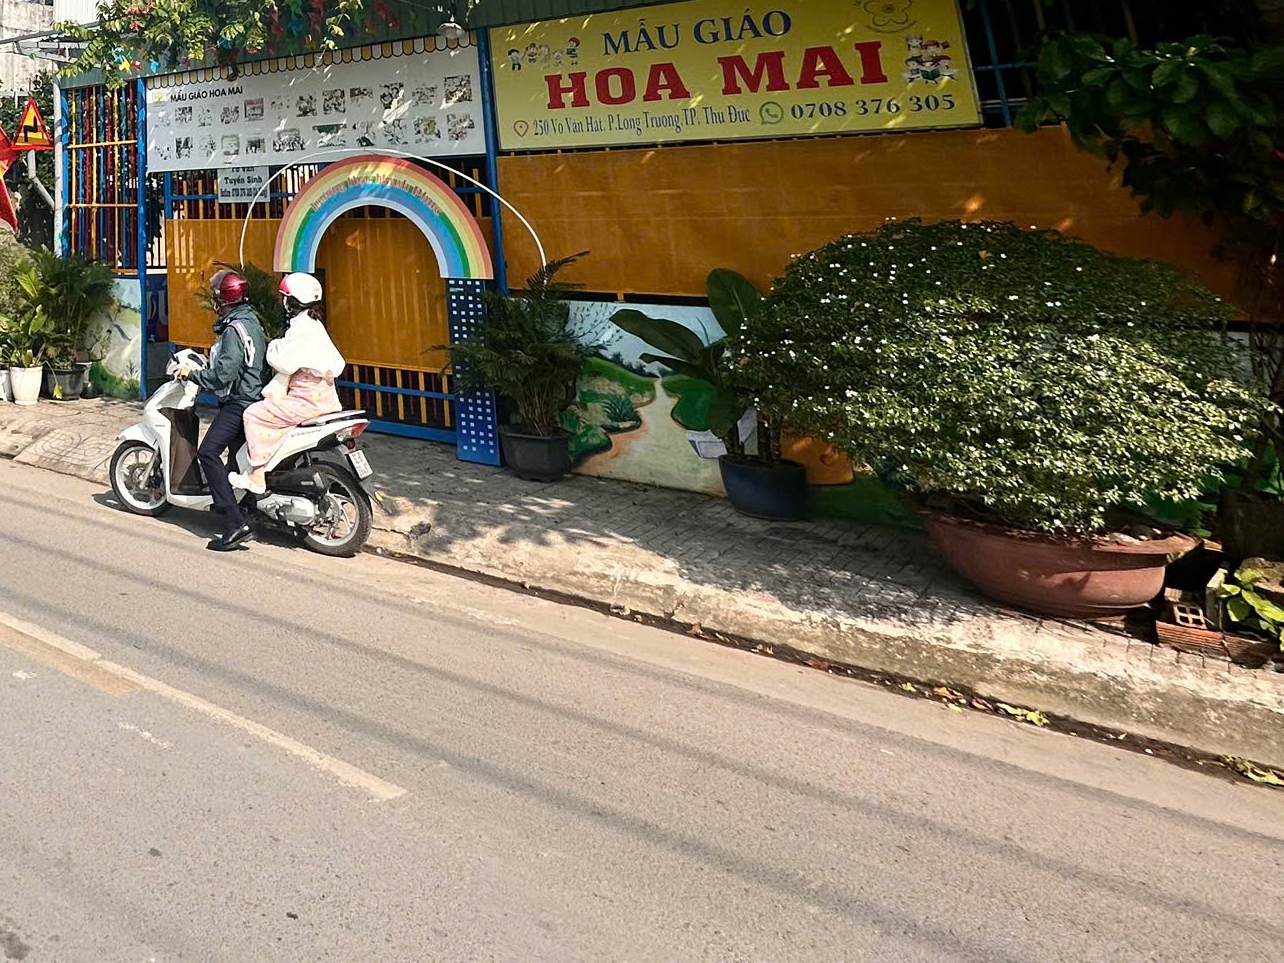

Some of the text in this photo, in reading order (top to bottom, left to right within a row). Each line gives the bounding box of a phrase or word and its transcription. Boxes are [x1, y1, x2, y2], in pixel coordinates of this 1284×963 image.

[601, 8, 792, 56] MẪU GIÁO
[544, 41, 889, 109] HOA MAI
[209, 87, 227, 98] HOA
[227, 86, 243, 95] MAI
[791, 94, 956, 119] 0708 376 305
[532, 119, 550, 136] 250
[247, 175, 263, 184] Sinh
